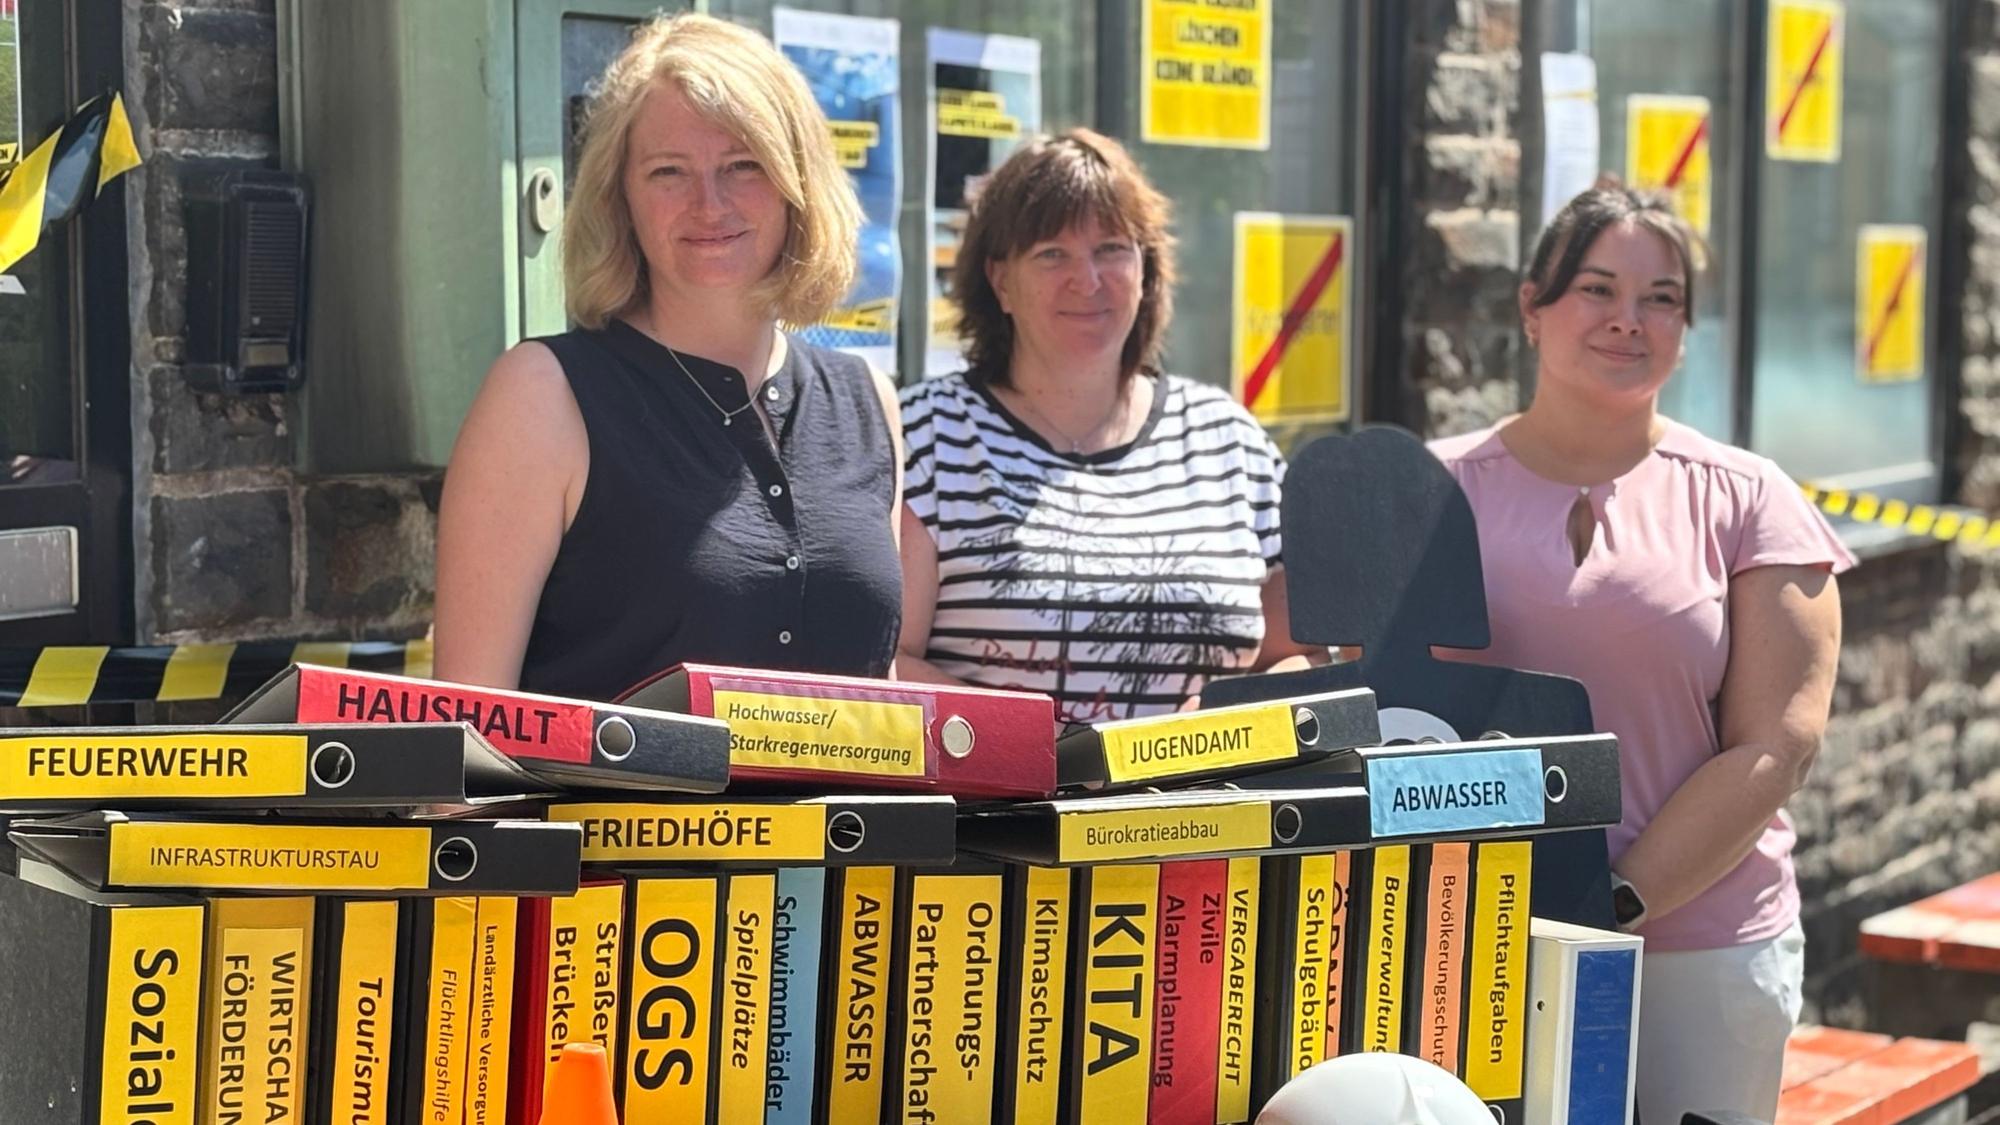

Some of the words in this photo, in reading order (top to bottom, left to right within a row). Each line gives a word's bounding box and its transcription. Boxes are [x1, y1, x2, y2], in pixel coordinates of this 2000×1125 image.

[28, 747, 248, 778] FEUERWEHR
[337, 683, 558, 745] HAUSHALT
[728, 702, 837, 730] Hochwasser/
[729, 733, 912, 766] Starkregenversorgung
[1130, 726, 1253, 765] JUGENDAMT
[150, 847, 380, 870] INFRASTRUKTURSTAU
[583, 810, 772, 848] FRIEDHÖFE
[1086, 821, 1219, 846] Bürokratieabbau
[1392, 781, 1508, 813] ABWASSER
[479, 925, 498, 1039] Landärztliche
[634, 918, 701, 1090] OGS
[731, 910, 760, 1069] Spielplätze
[767, 895, 797, 1111] Schwimmbäder
[844, 893, 881, 1083] ABWASSER
[955, 902, 993, 1081] Ordnungs-
[1027, 899, 1058, 1084] Klimaschutz
[1087, 903, 1147, 1076] KITA
[1153, 895, 1186, 1088] Alarmplanung
[1200, 892, 1221, 964] Zivile
[1224, 888, 1249, 1086] VERGABERECHT
[1489, 874, 1515, 1064] Pflichtaufgaben
[127, 948, 179, 1125] Sozial
[434, 969, 457, 1122] Flüchtlingshilfe
